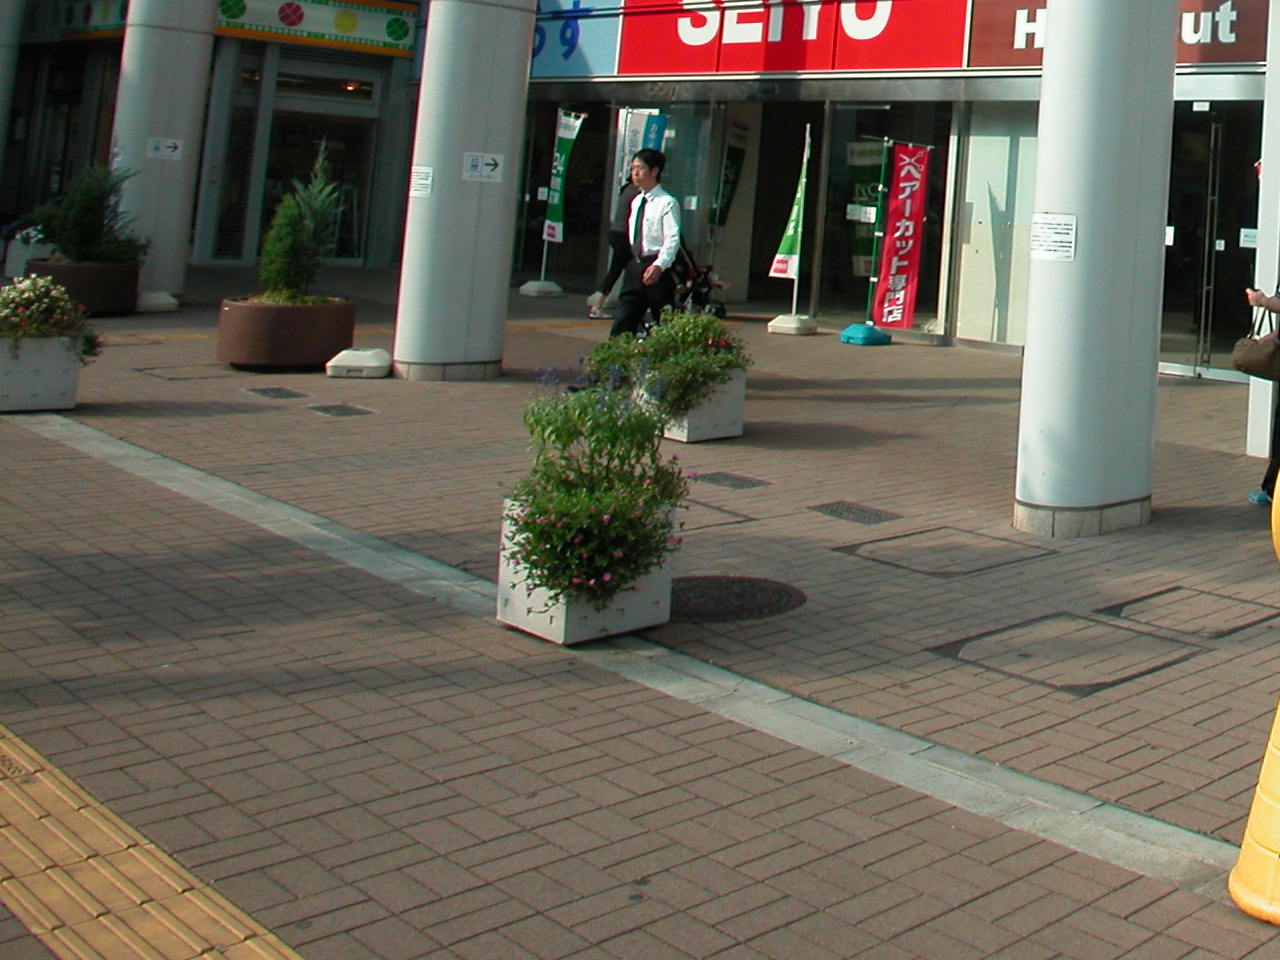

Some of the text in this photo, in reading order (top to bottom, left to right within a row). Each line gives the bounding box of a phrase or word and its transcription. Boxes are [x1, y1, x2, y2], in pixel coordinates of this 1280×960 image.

[882, 164, 922, 323] ヘアーカット専門店
